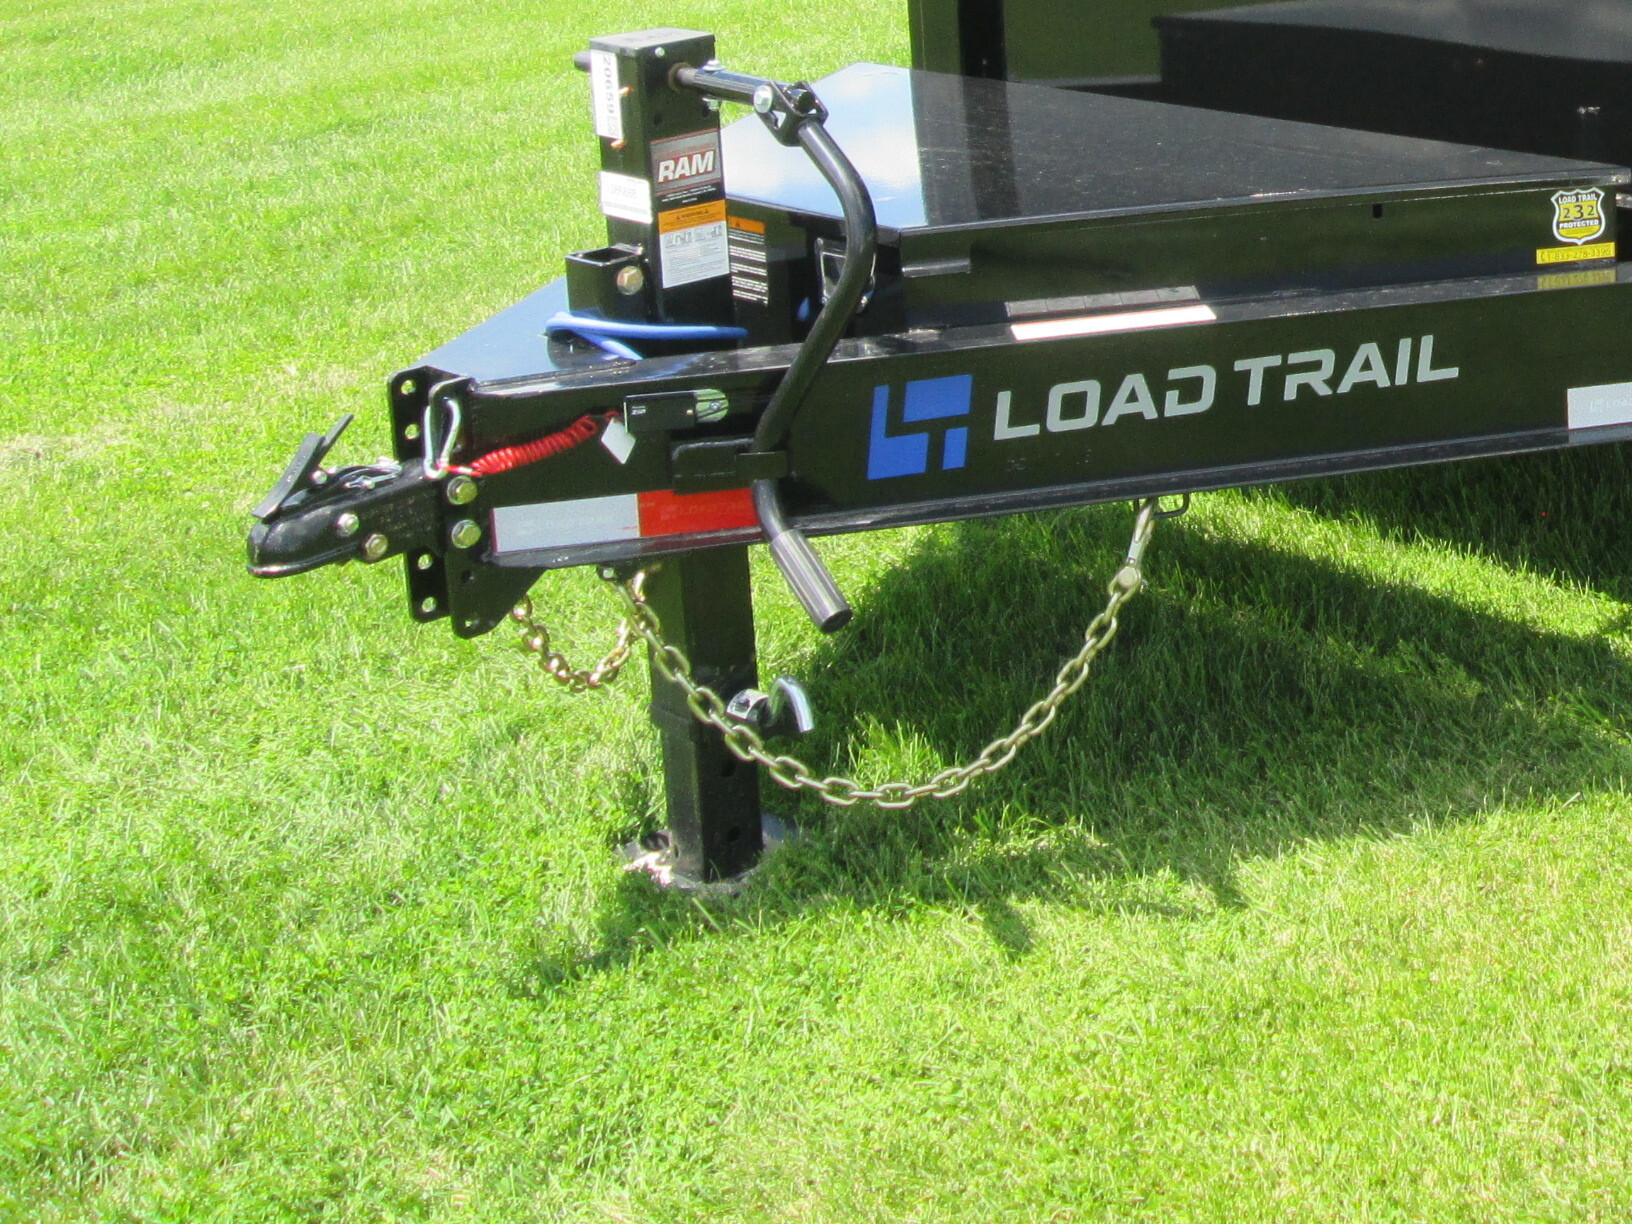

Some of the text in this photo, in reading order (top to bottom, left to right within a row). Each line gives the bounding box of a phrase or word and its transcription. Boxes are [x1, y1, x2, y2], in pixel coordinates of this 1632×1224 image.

[658, 151, 714, 182] RAM
[1558, 193, 1598, 204] LOAD TRAIL
[1559, 219, 1600, 229] PROTECTED
[994, 334, 1459, 441] LOAD TRAIL
